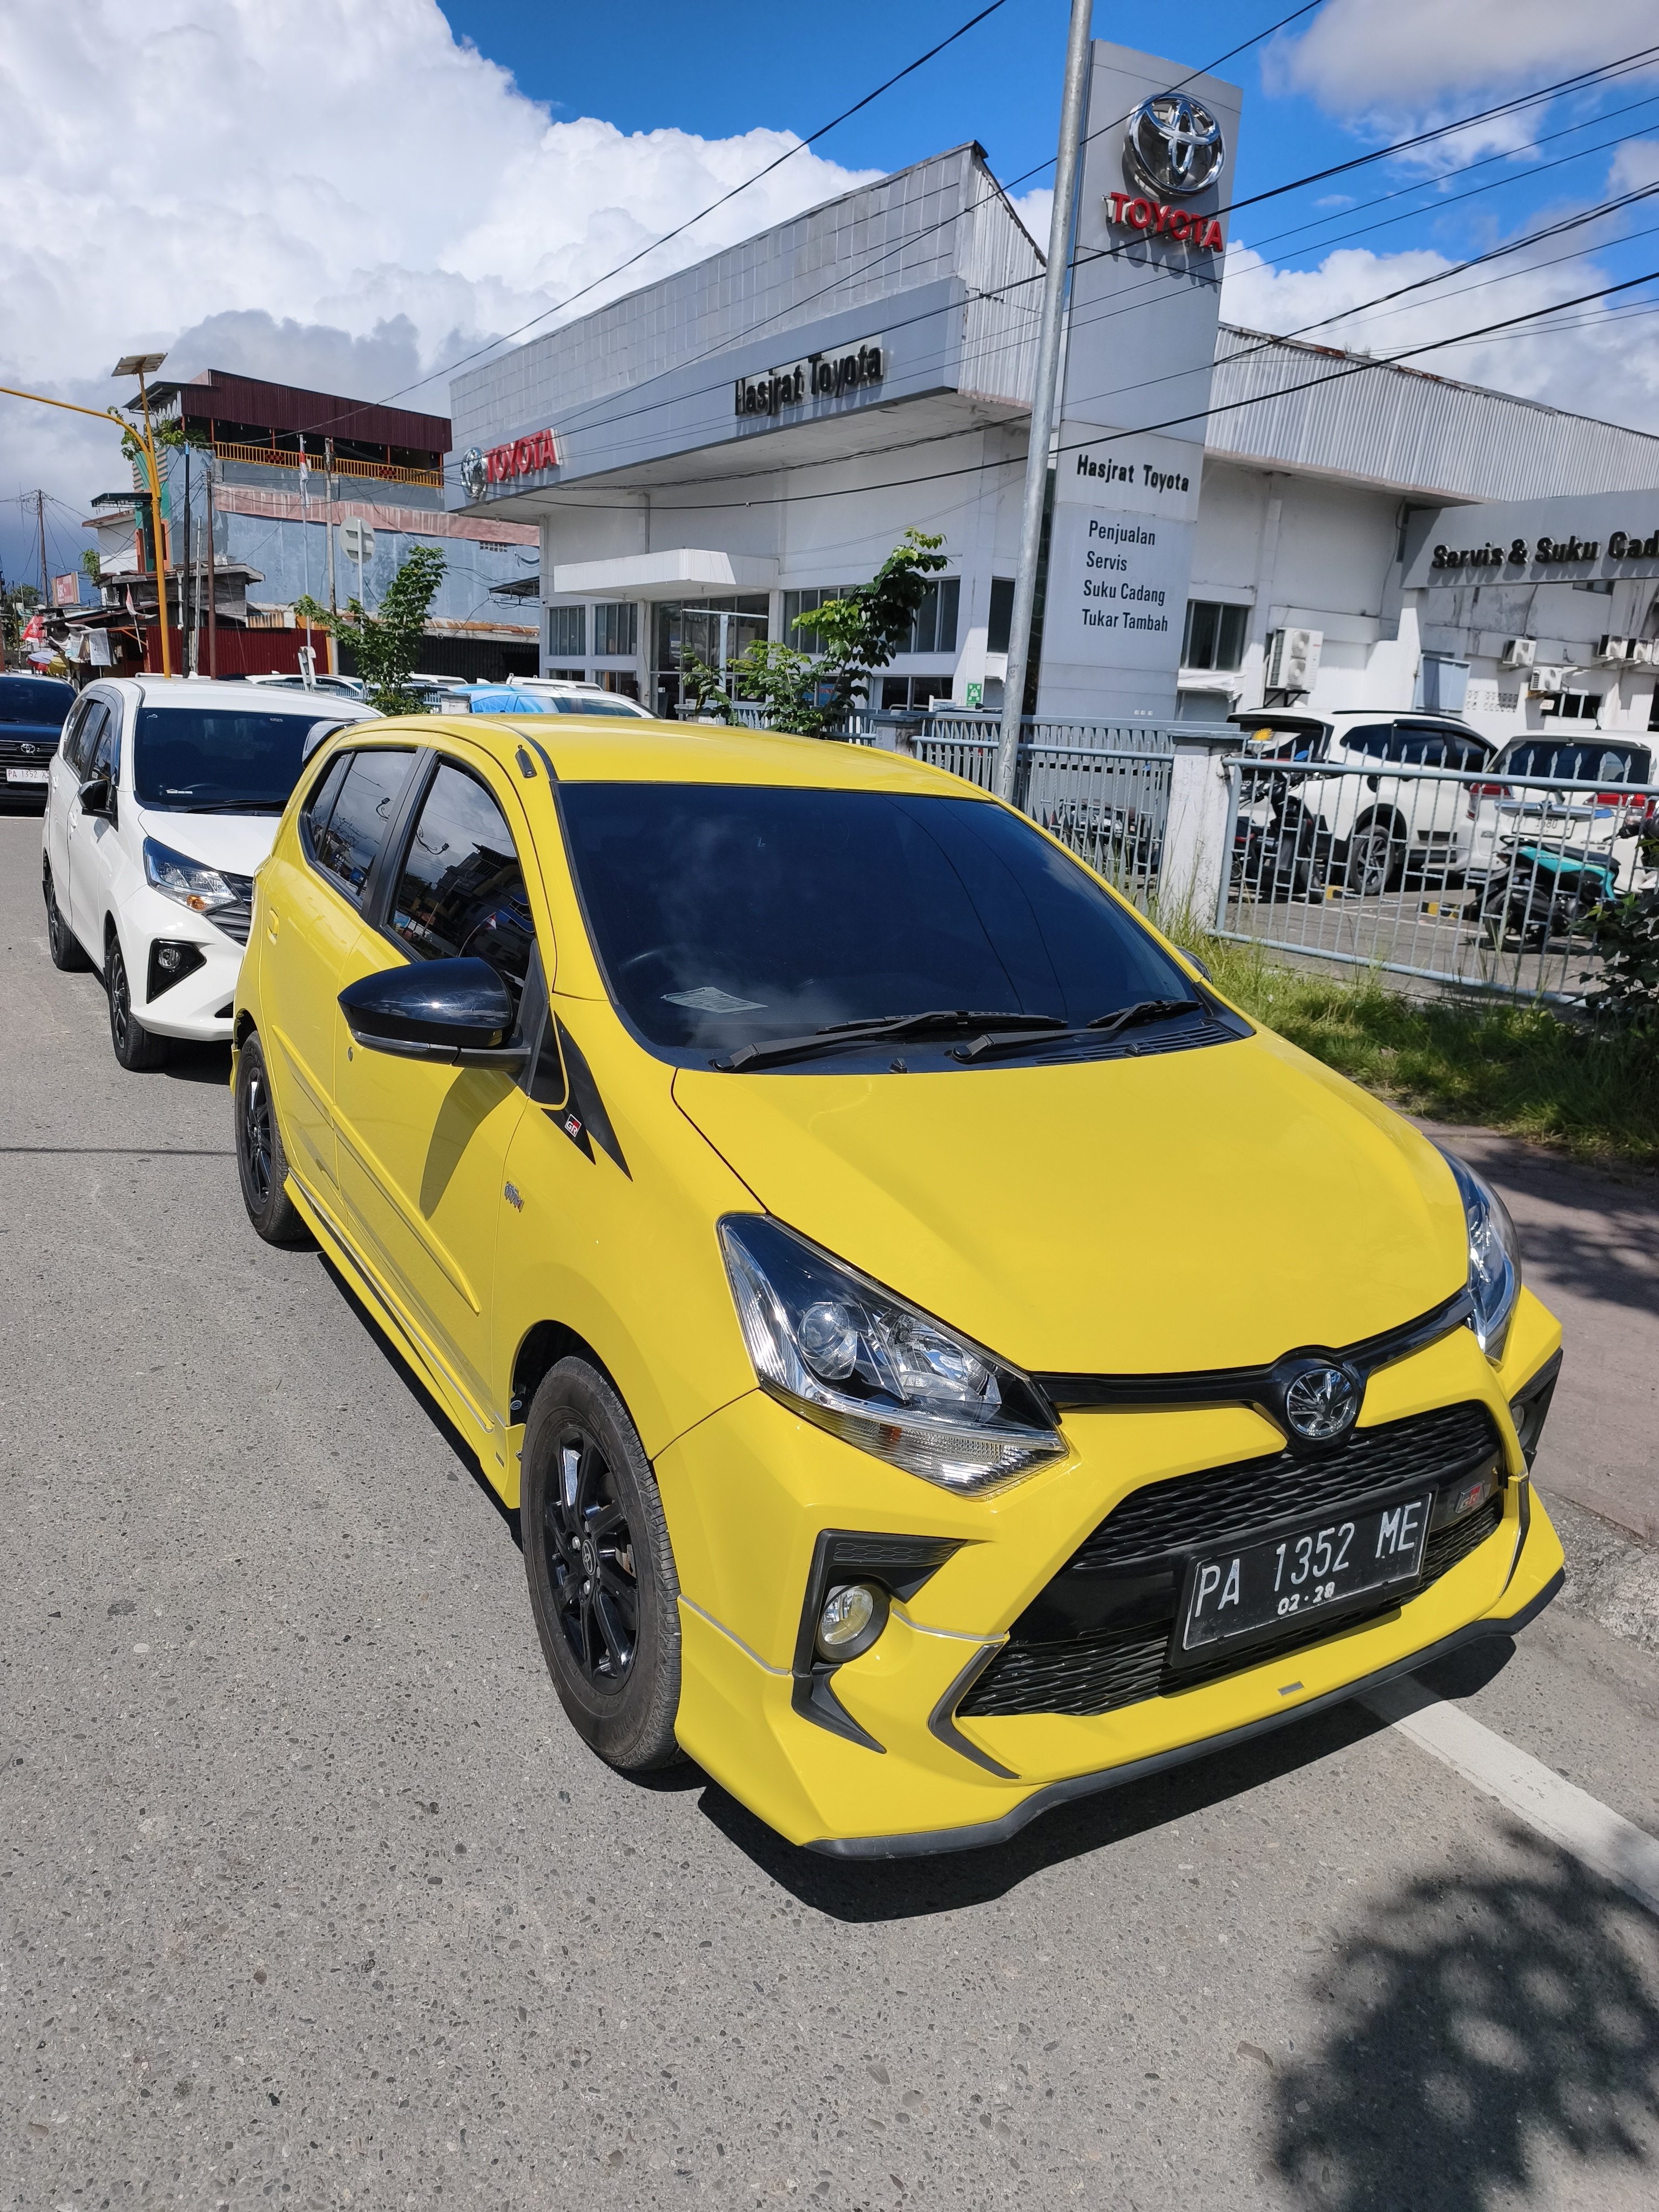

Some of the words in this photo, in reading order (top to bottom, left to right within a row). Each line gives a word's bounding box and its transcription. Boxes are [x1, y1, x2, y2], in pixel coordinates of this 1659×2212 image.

[1107, 192, 1224, 253] TOYOTA
[735, 363, 805, 416] Hasjrat
[808, 344, 884, 399] Toyota
[484, 428, 558, 483] TOYOTA
[1077, 454, 1134, 483] Hasjrat
[1143, 464, 1190, 494] Toyota
[1089, 520, 1156, 545] Penjualan
[1086, 551, 1128, 572] Servis
[1431, 541, 1506, 568] Servis
[1508, 538, 1528, 565] &
[1535, 535, 1601, 563] Suku
[1083, 580, 1117, 599] Suku
[1121, 583, 1166, 607] Cadang
[1082, 609, 1119, 629] Tukar
[1123, 611, 1168, 632] Tambah
[8, 770, 17, 778] PA
[21, 771, 38, 779] 1352
[1459, 1492, 1479, 1510] GR
[1195, 1557, 1240, 1617] PA
[1273, 1522, 1355, 1593] 1352
[1375, 1501, 1422, 1559] ME
